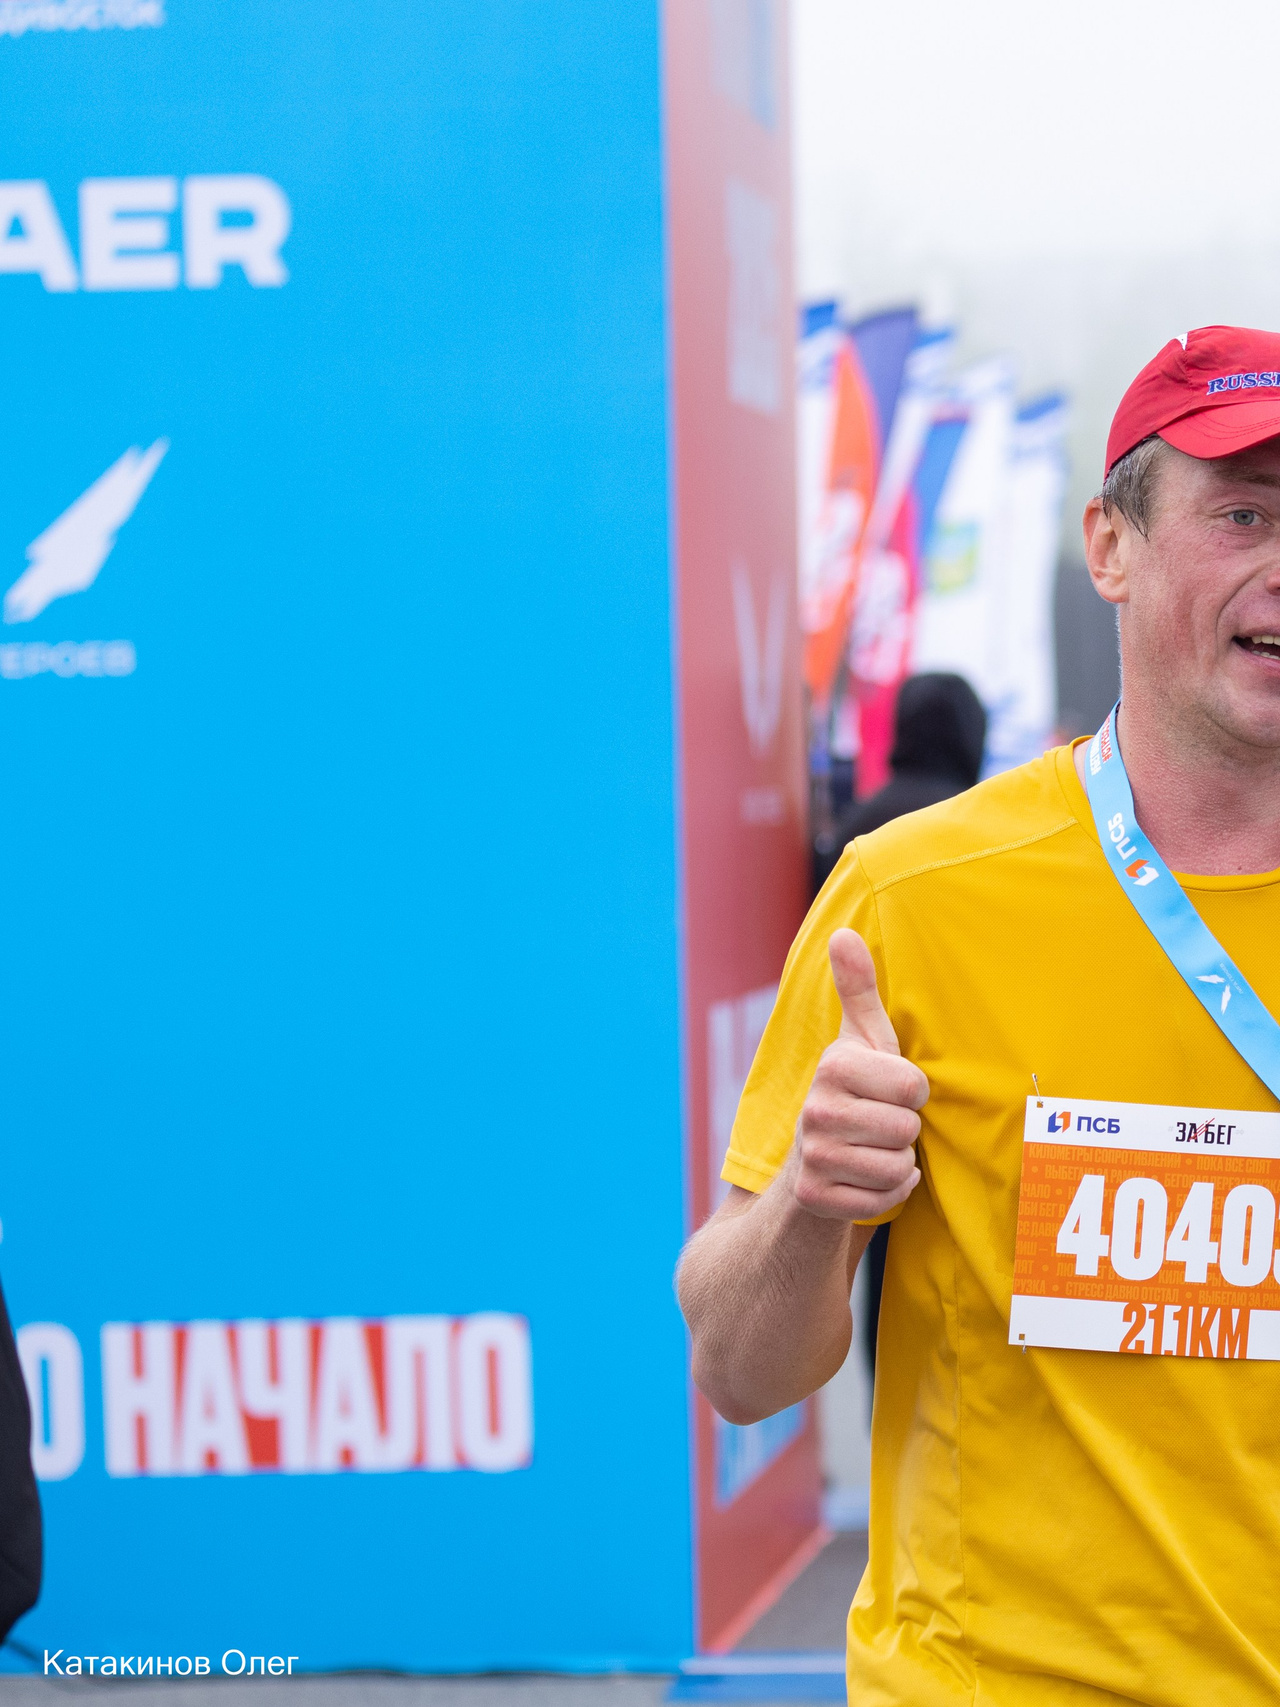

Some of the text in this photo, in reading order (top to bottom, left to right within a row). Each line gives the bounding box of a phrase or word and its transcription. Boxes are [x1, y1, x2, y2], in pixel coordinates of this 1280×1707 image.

[1108, 812, 1138, 860] ПСБ
[1077, 1116, 1120, 1134] ПСБ
[1029, 1143, 1093, 1162] КИЛОМЕТРЫ
[1196, 1155, 1272, 1175] ПОКА ВСЕ СПЯТ
[1065, 1281, 1180, 1303] СТРЕСС ДАВНО ОТСТАЛ
[102, 1312, 534, 1479] НАЧАЛО
